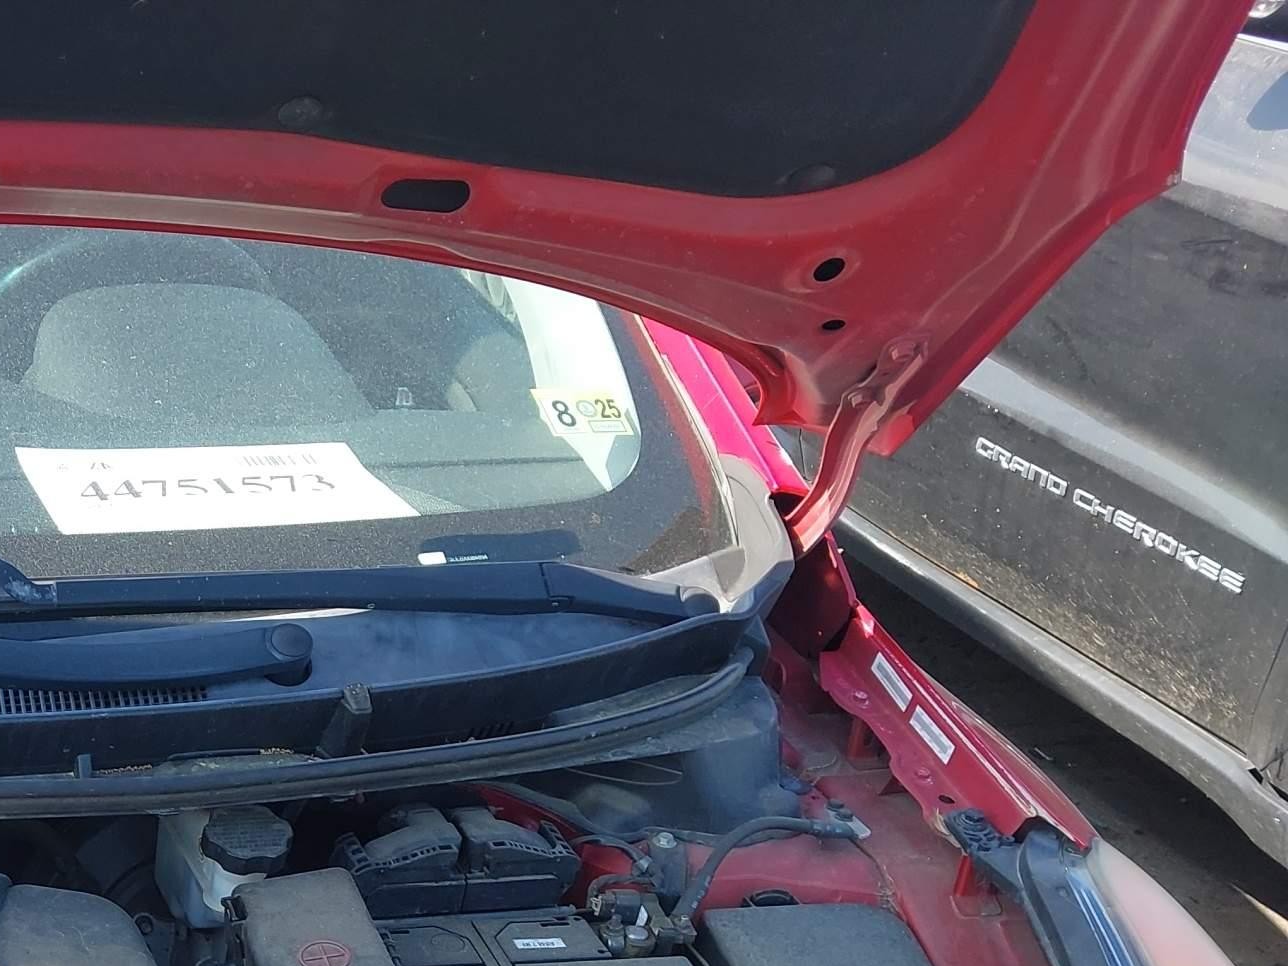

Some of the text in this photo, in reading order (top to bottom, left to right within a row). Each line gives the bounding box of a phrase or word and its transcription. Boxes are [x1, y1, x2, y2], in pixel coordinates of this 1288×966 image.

[551, 399, 577, 427] 8
[593, 398, 622, 419] 25
[80, 473, 337, 501] 44751573
[975, 436, 1247, 594] GRAND CHEROKEE
